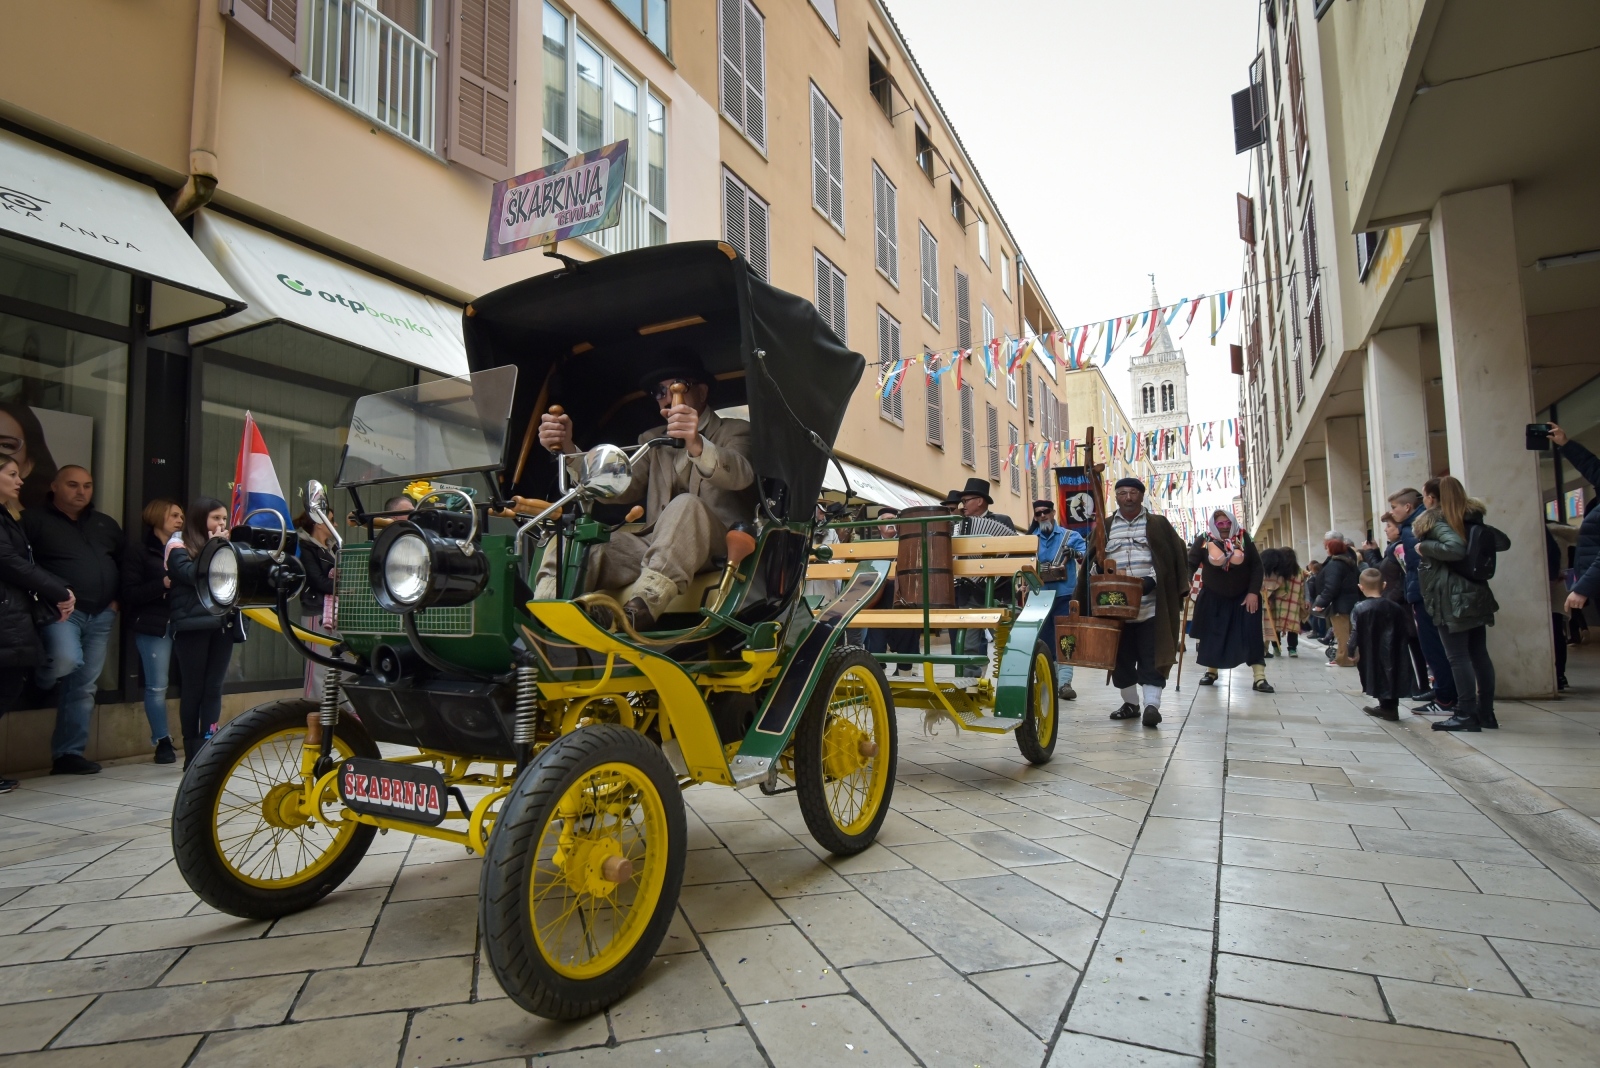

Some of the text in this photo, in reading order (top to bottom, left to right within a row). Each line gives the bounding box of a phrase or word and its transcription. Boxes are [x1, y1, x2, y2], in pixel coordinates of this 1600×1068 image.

[504, 164, 603, 227] ŠKABRNJA
[60, 221, 142, 252] ANDA
[344, 763, 441, 816] ŠKABRNJA
